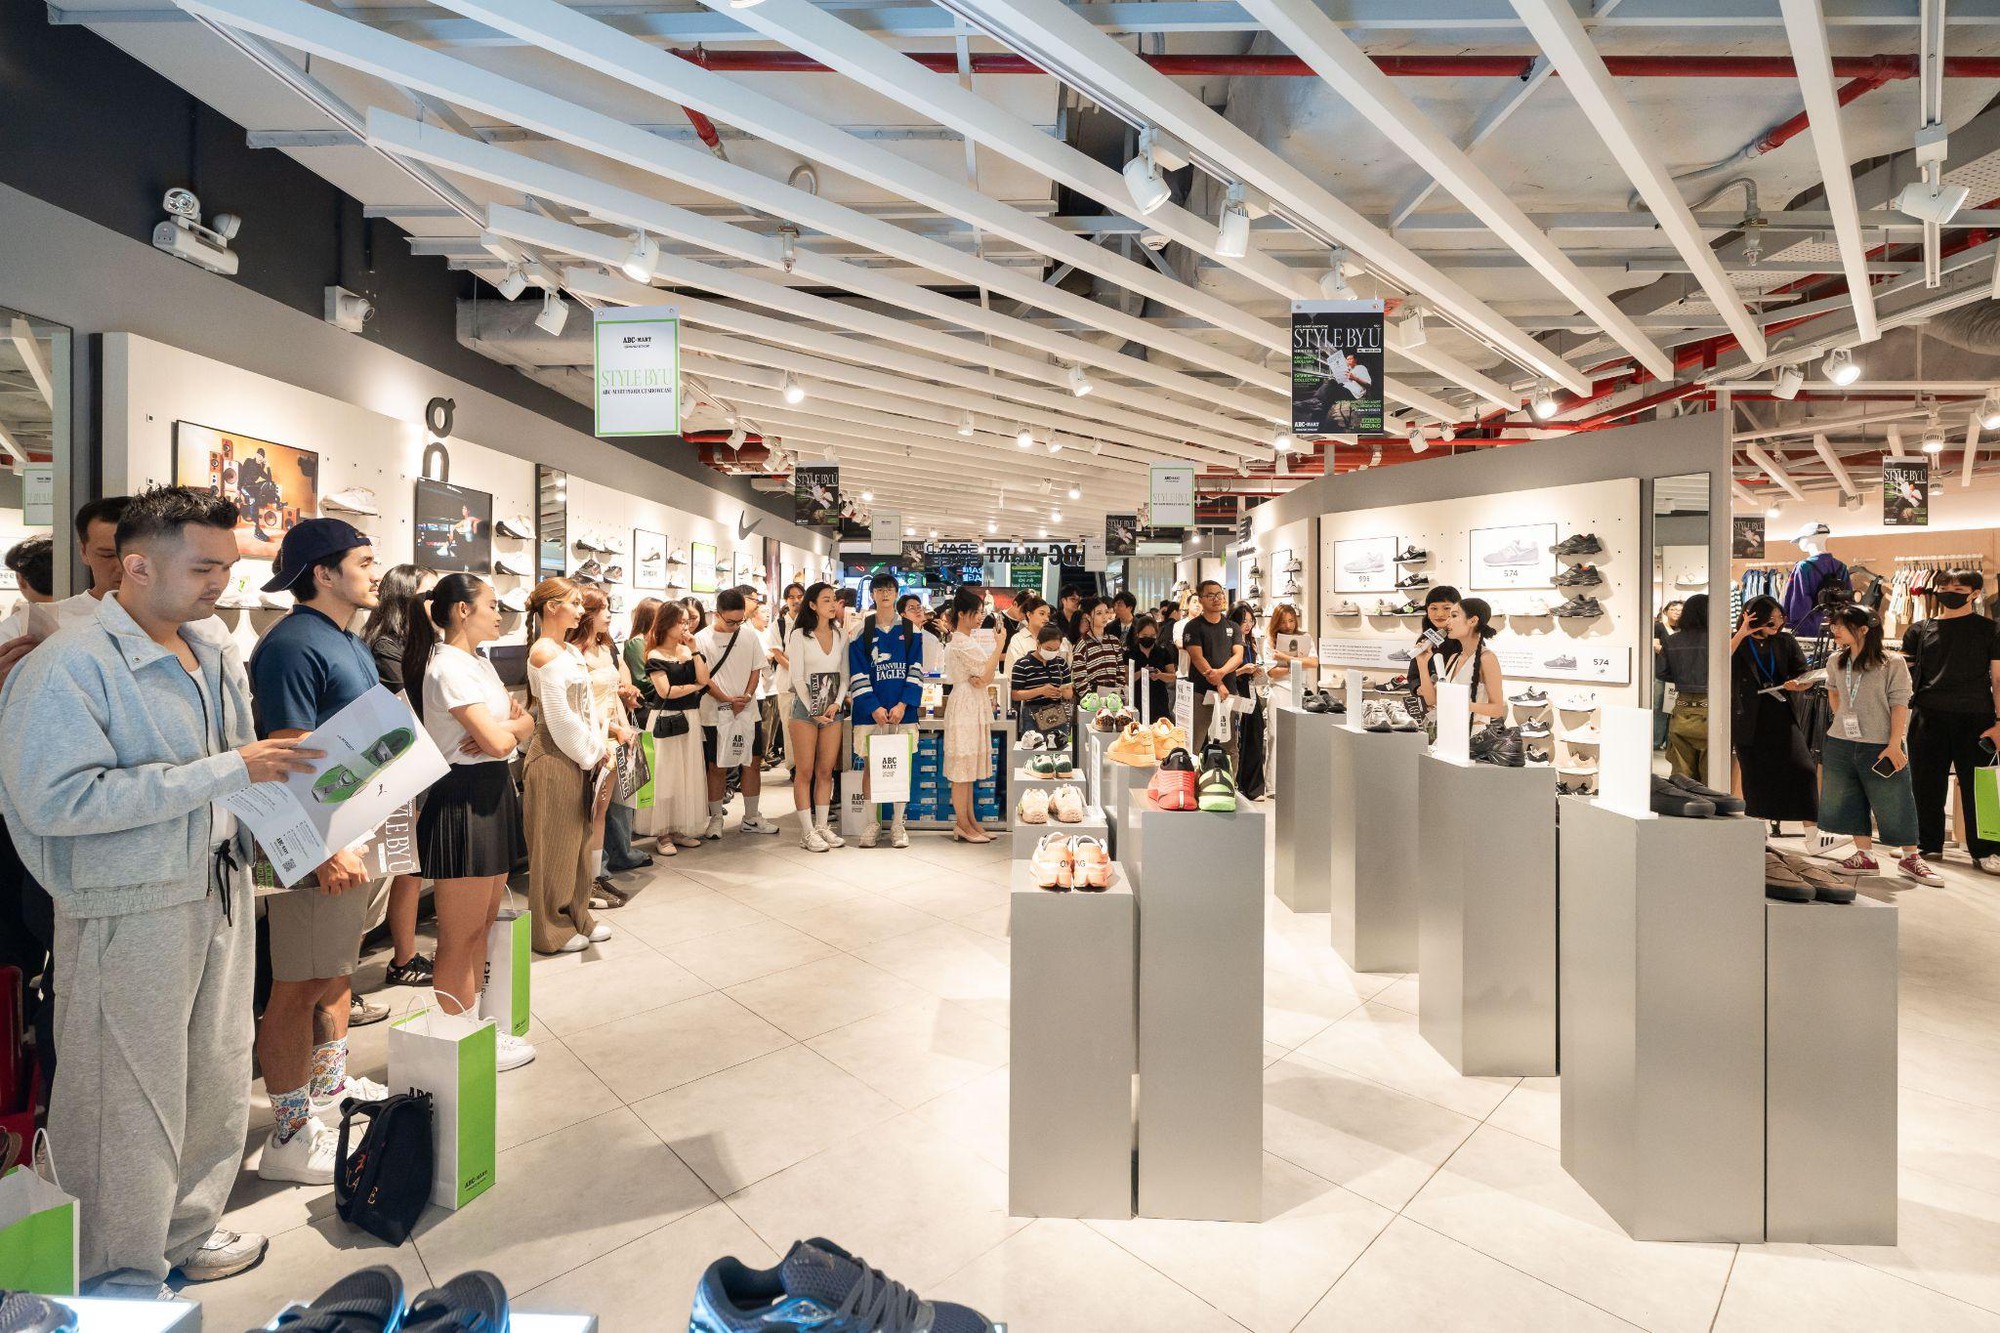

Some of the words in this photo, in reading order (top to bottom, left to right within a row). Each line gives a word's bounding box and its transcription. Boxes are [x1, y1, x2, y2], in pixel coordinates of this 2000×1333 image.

[1294, 328, 1343, 348] STYLE
[1347, 328, 1366, 348] BY
[1367, 328, 1381, 347] U
[602, 369, 642, 387] STYLE
[644, 369, 659, 386] BY
[660, 368, 672, 385] U
[797, 474, 820, 484] STYLE
[1884, 470, 1908, 481] STYLE
[1910, 470, 1920, 480] BY
[1594, 658, 1609, 666] 574
[876, 670, 906, 681] EAGLES
[386, 836, 410, 858] BY
[388, 859, 412, 874] U
[464, 1170, 488, 1188] ABC-MART
